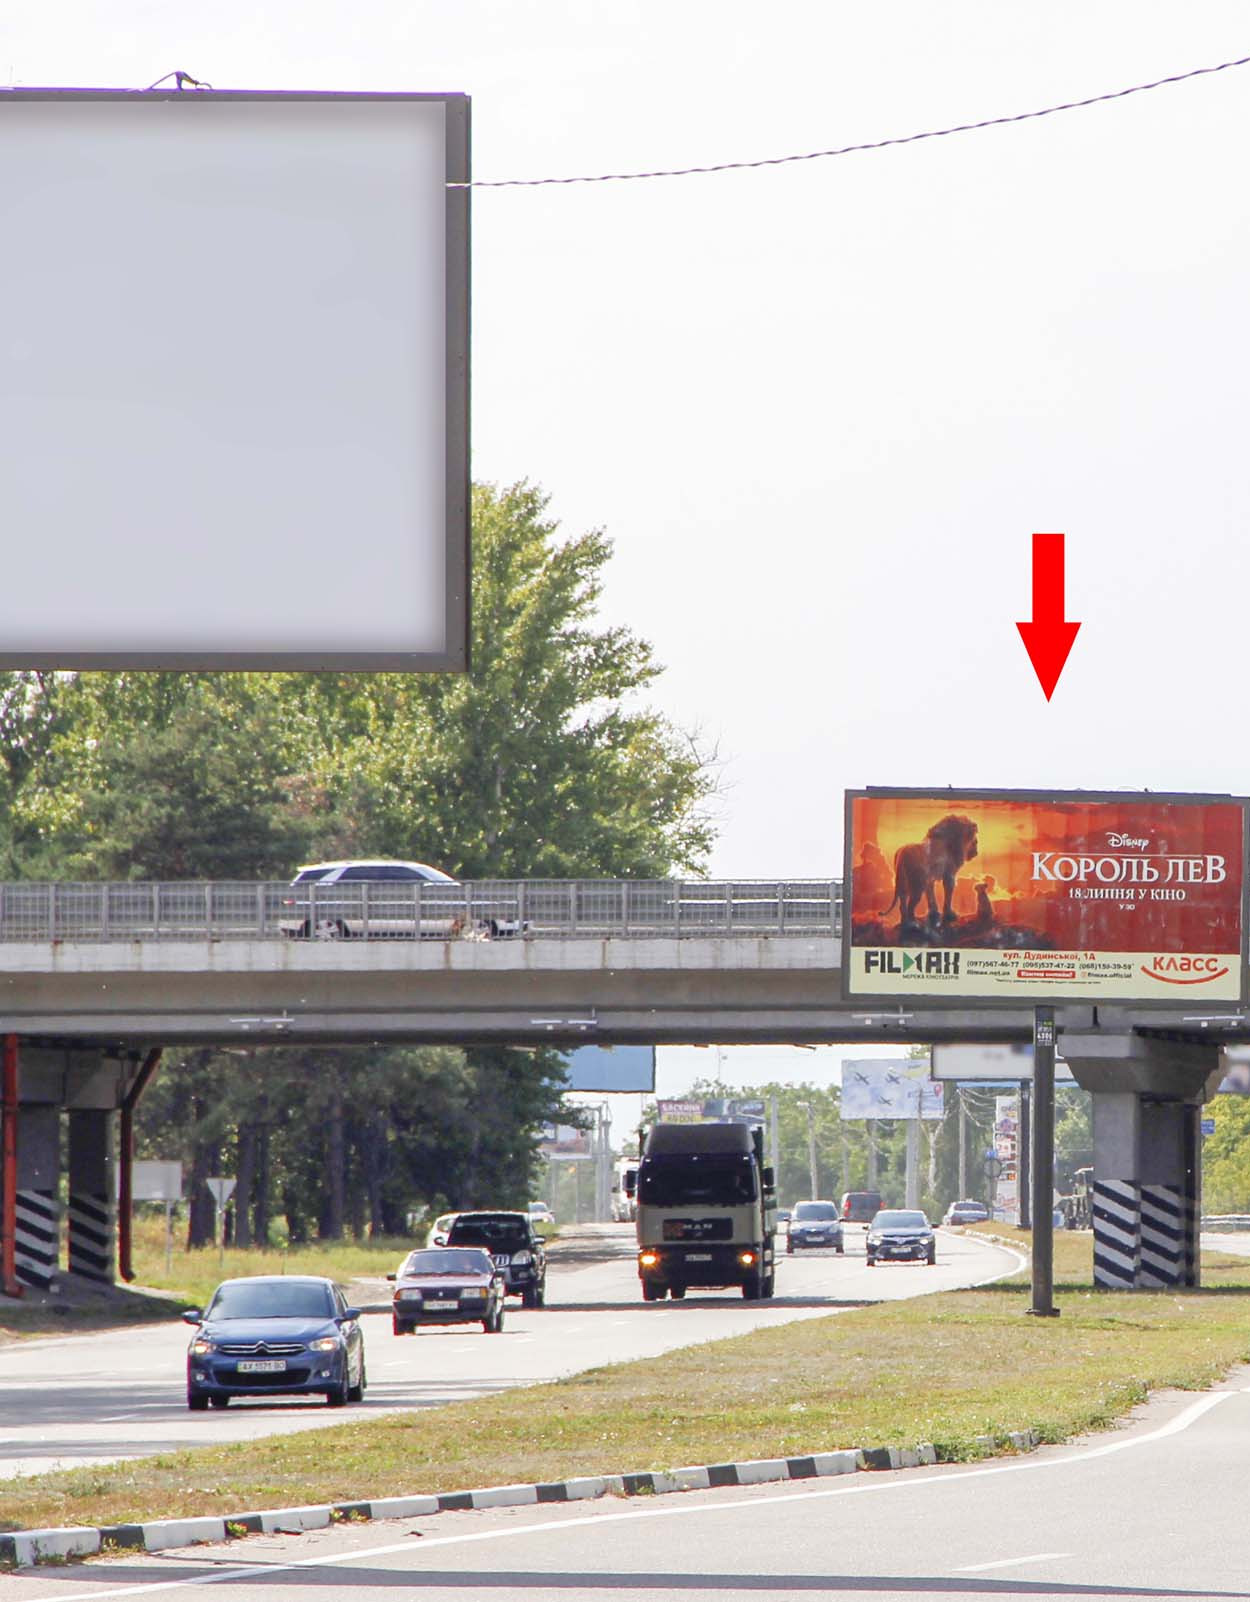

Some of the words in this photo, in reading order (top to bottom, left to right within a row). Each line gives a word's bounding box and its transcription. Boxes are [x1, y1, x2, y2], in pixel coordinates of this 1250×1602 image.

[1105, 832, 1149, 851] Disney
[1031, 852, 1159, 882] КОРОЛЬ
[1164, 855, 1226, 883] ЛЕВ
[1069, 888, 1082, 898] 18
[1084, 888, 1134, 899] ЛИПНЯ
[1138, 888, 1148, 899] У
[1151, 889, 1186, 901] КІНО
